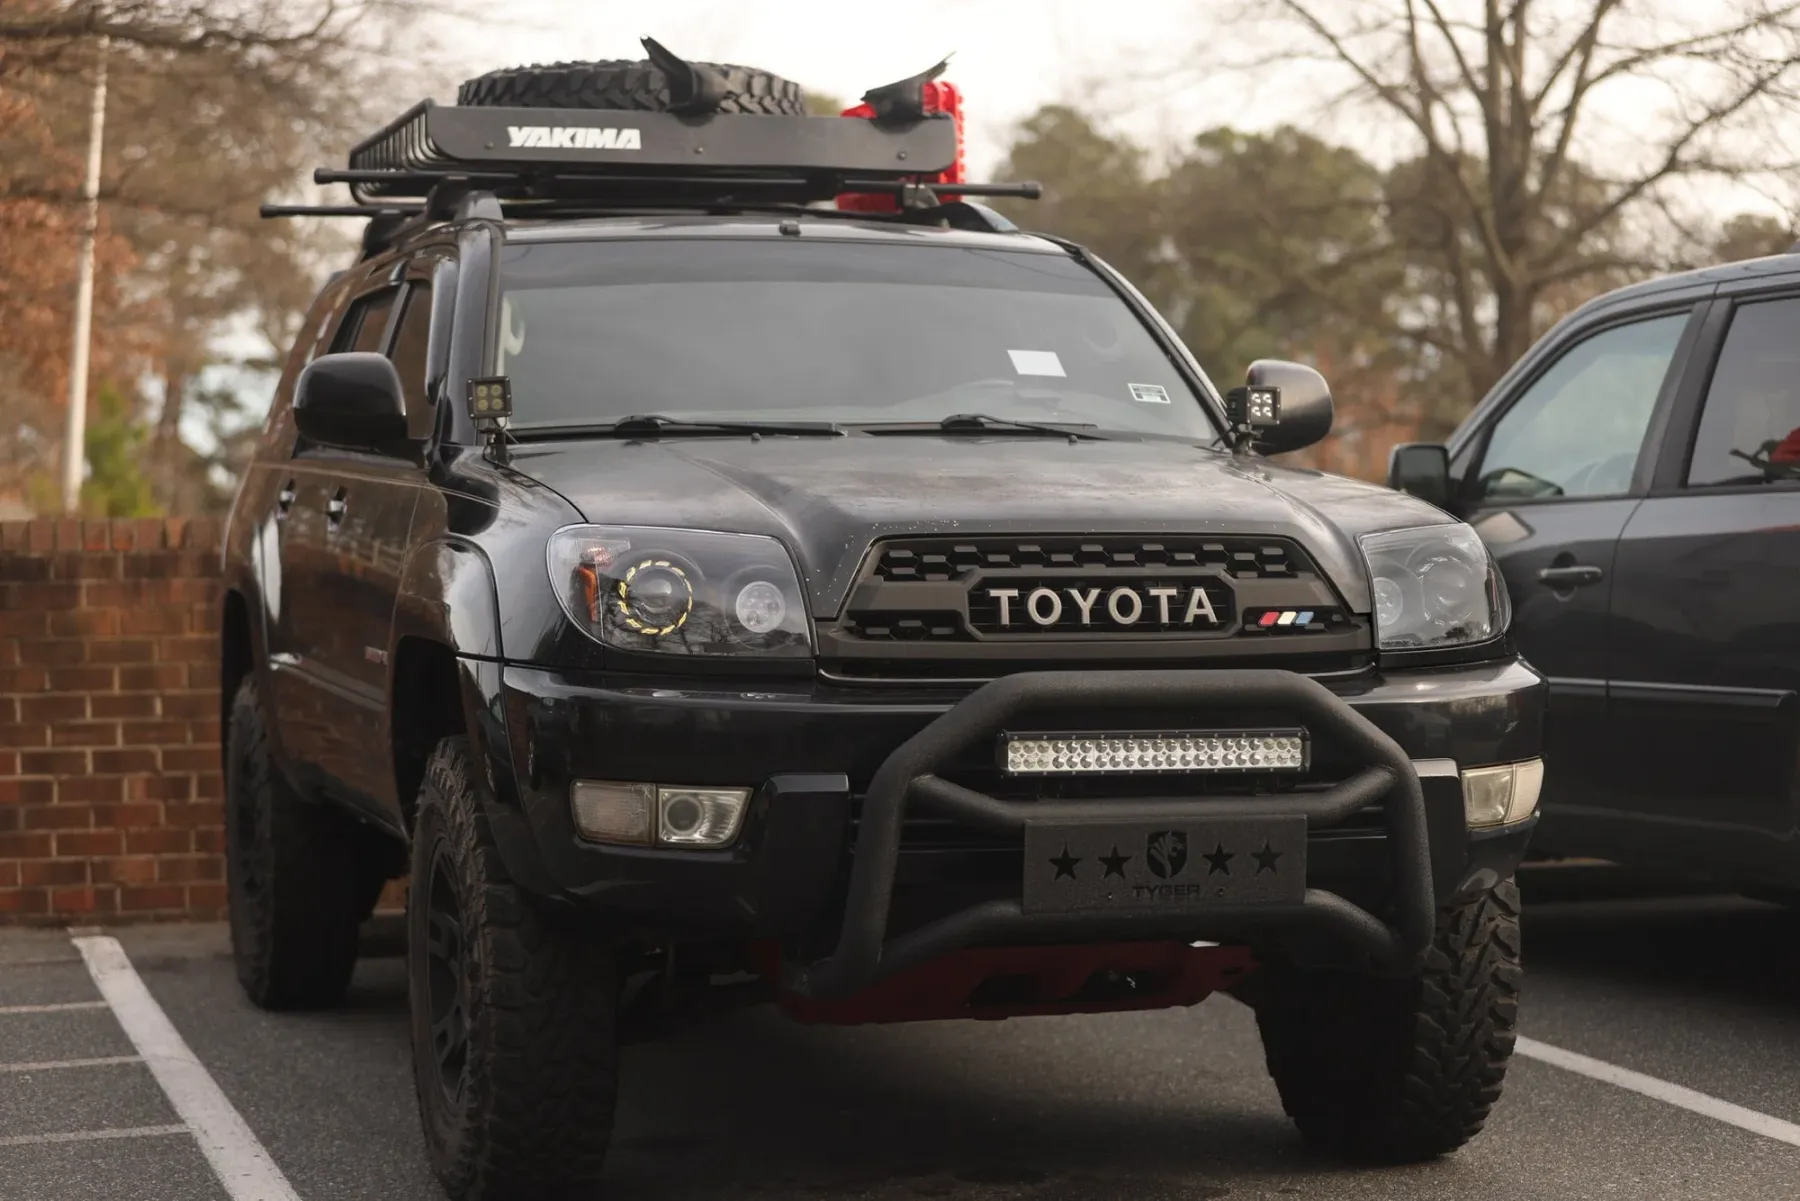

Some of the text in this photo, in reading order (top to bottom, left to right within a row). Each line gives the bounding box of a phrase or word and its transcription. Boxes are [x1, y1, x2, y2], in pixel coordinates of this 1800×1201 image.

[507, 126, 641, 150] YAKIMA
[989, 587, 1218, 625] TOYOTA
[1132, 883, 1200, 898] TYGER
